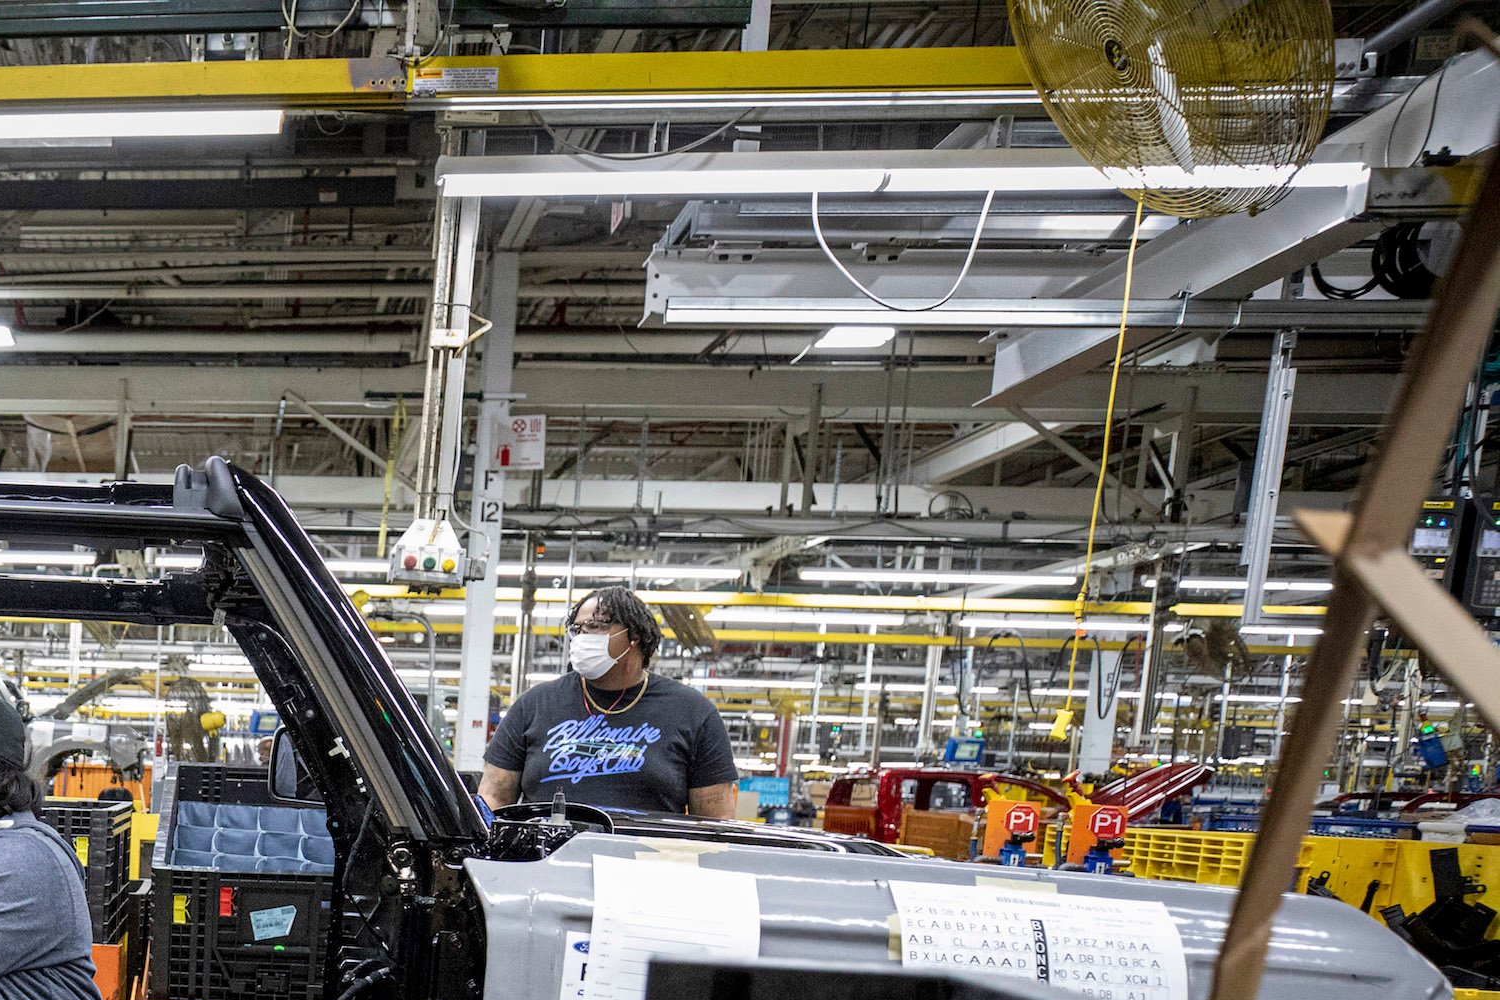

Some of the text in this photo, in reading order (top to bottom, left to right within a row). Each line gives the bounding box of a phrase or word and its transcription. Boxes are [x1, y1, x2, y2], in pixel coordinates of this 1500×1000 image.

[484, 470, 500, 490] F
[481, 501, 500, 522] 12
[543, 714, 661, 752] Billionaire
[549, 742, 647, 784] Boys Club
[1009, 811, 1035, 831] P1
[1094, 813, 1122, 834] P1
[918, 919, 926, 928] C
[931, 920, 940, 929] A
[944, 921, 952, 930] B
[956, 921, 965, 931] B
[970, 922, 977, 931] P
[981, 924, 988, 933] A
[1008, 926, 1017, 935] C
[909, 934, 919, 944] A
[923, 935, 934, 945] B
[981, 939, 990, 949] A
[1011, 941, 1020, 951] C
[1023, 942, 1032, 952] A
[1063, 936, 1071, 946] P
[1129, 942, 1137, 951] A
[1141, 942, 1151, 952] A
[909, 950, 918, 960] B
[923, 951, 930, 961] X
[953, 953, 964, 964] C
[969, 955, 981, 965] A
[986, 956, 996, 966] A
[1001, 957, 1013, 967] A
[1064, 952, 1075, 963] A
[1118, 956, 1128, 967] G
[1151, 959, 1161, 969] A
[1072, 970, 1081, 980] S
[1085, 971, 1097, 981] A
[1101, 972, 1110, 982] C
[1125, 974, 1149, 985] XCW
[1128, 991, 1136, 1000] A
